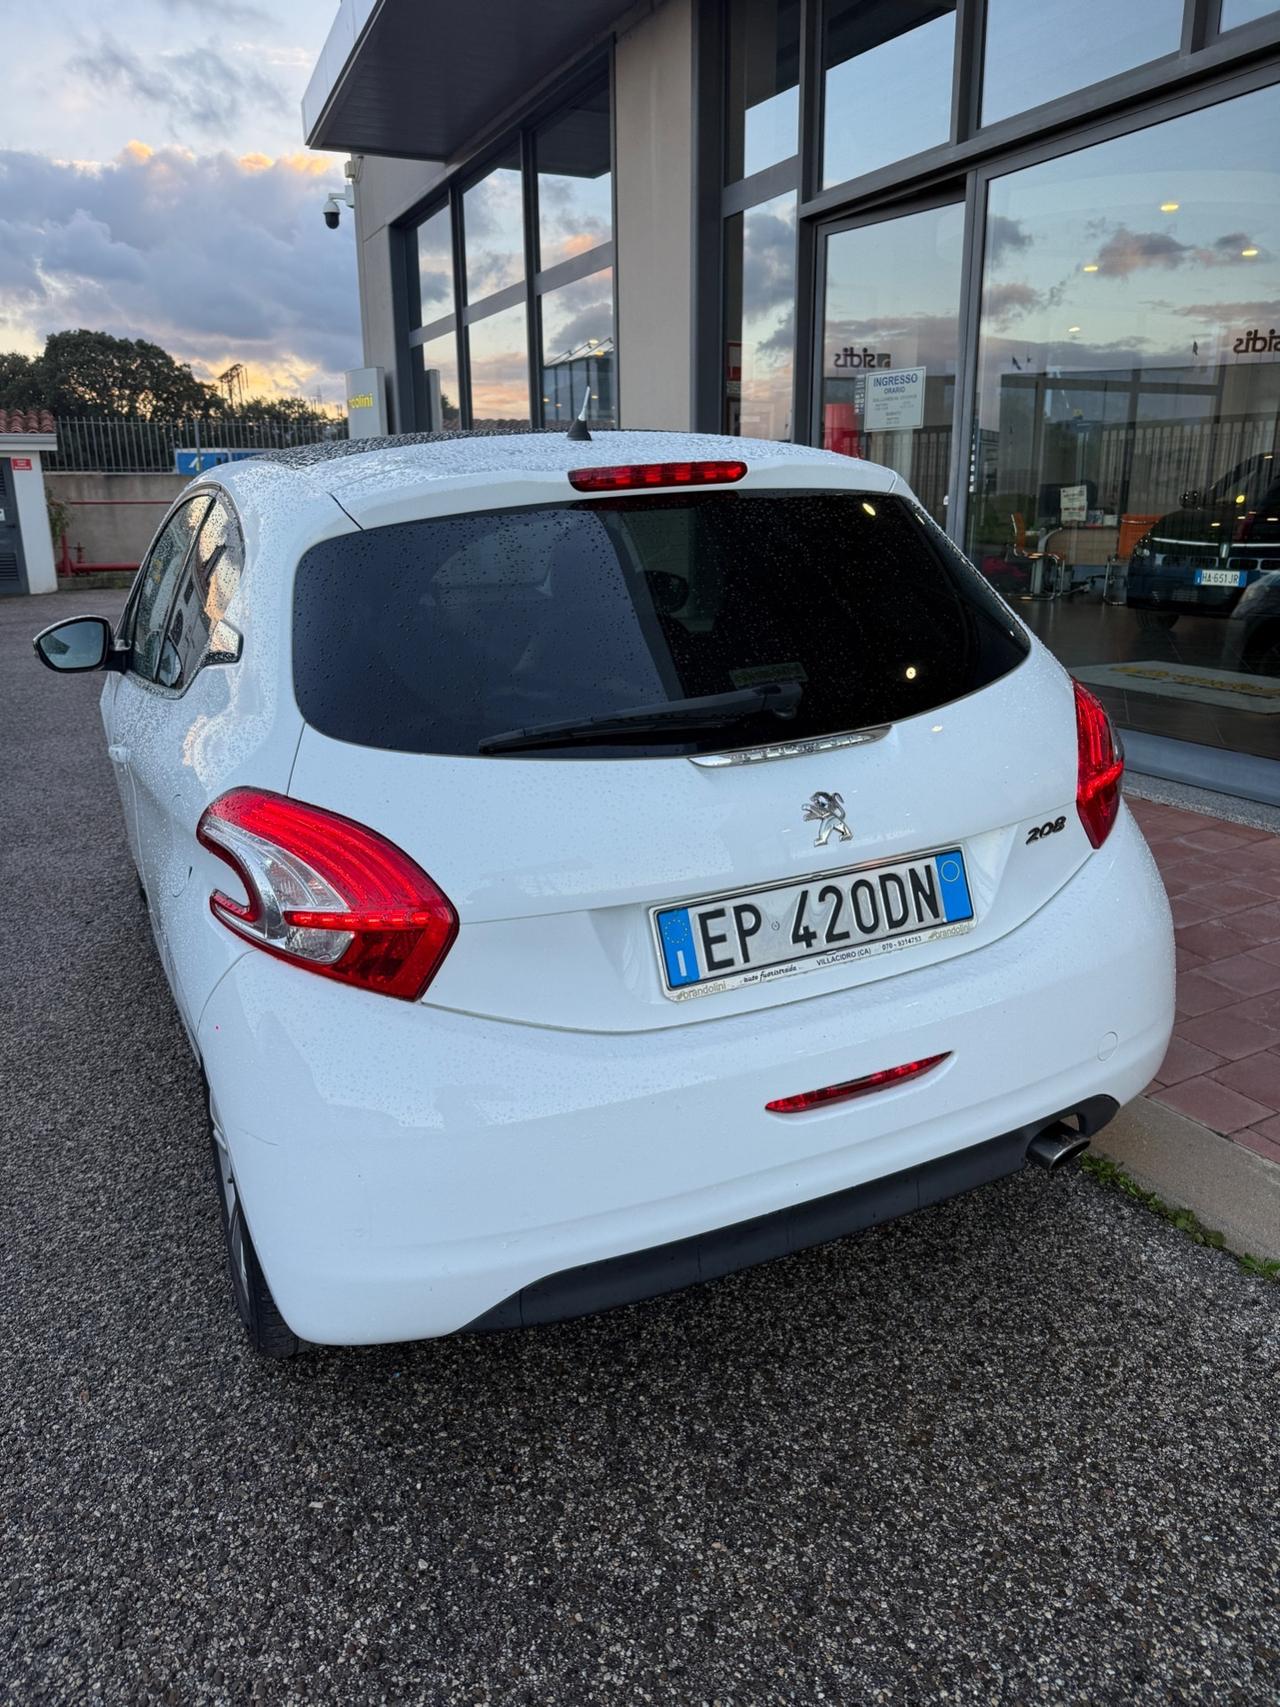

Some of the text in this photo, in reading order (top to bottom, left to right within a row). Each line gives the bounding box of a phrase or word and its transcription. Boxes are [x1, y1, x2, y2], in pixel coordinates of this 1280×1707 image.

[873, 373, 919, 388] INGRESSO
[1025, 815, 1067, 845] 208
[697, 864, 940, 972] EP 420DN
[816, 947, 872, 966] VILLACIDRO (CA)
